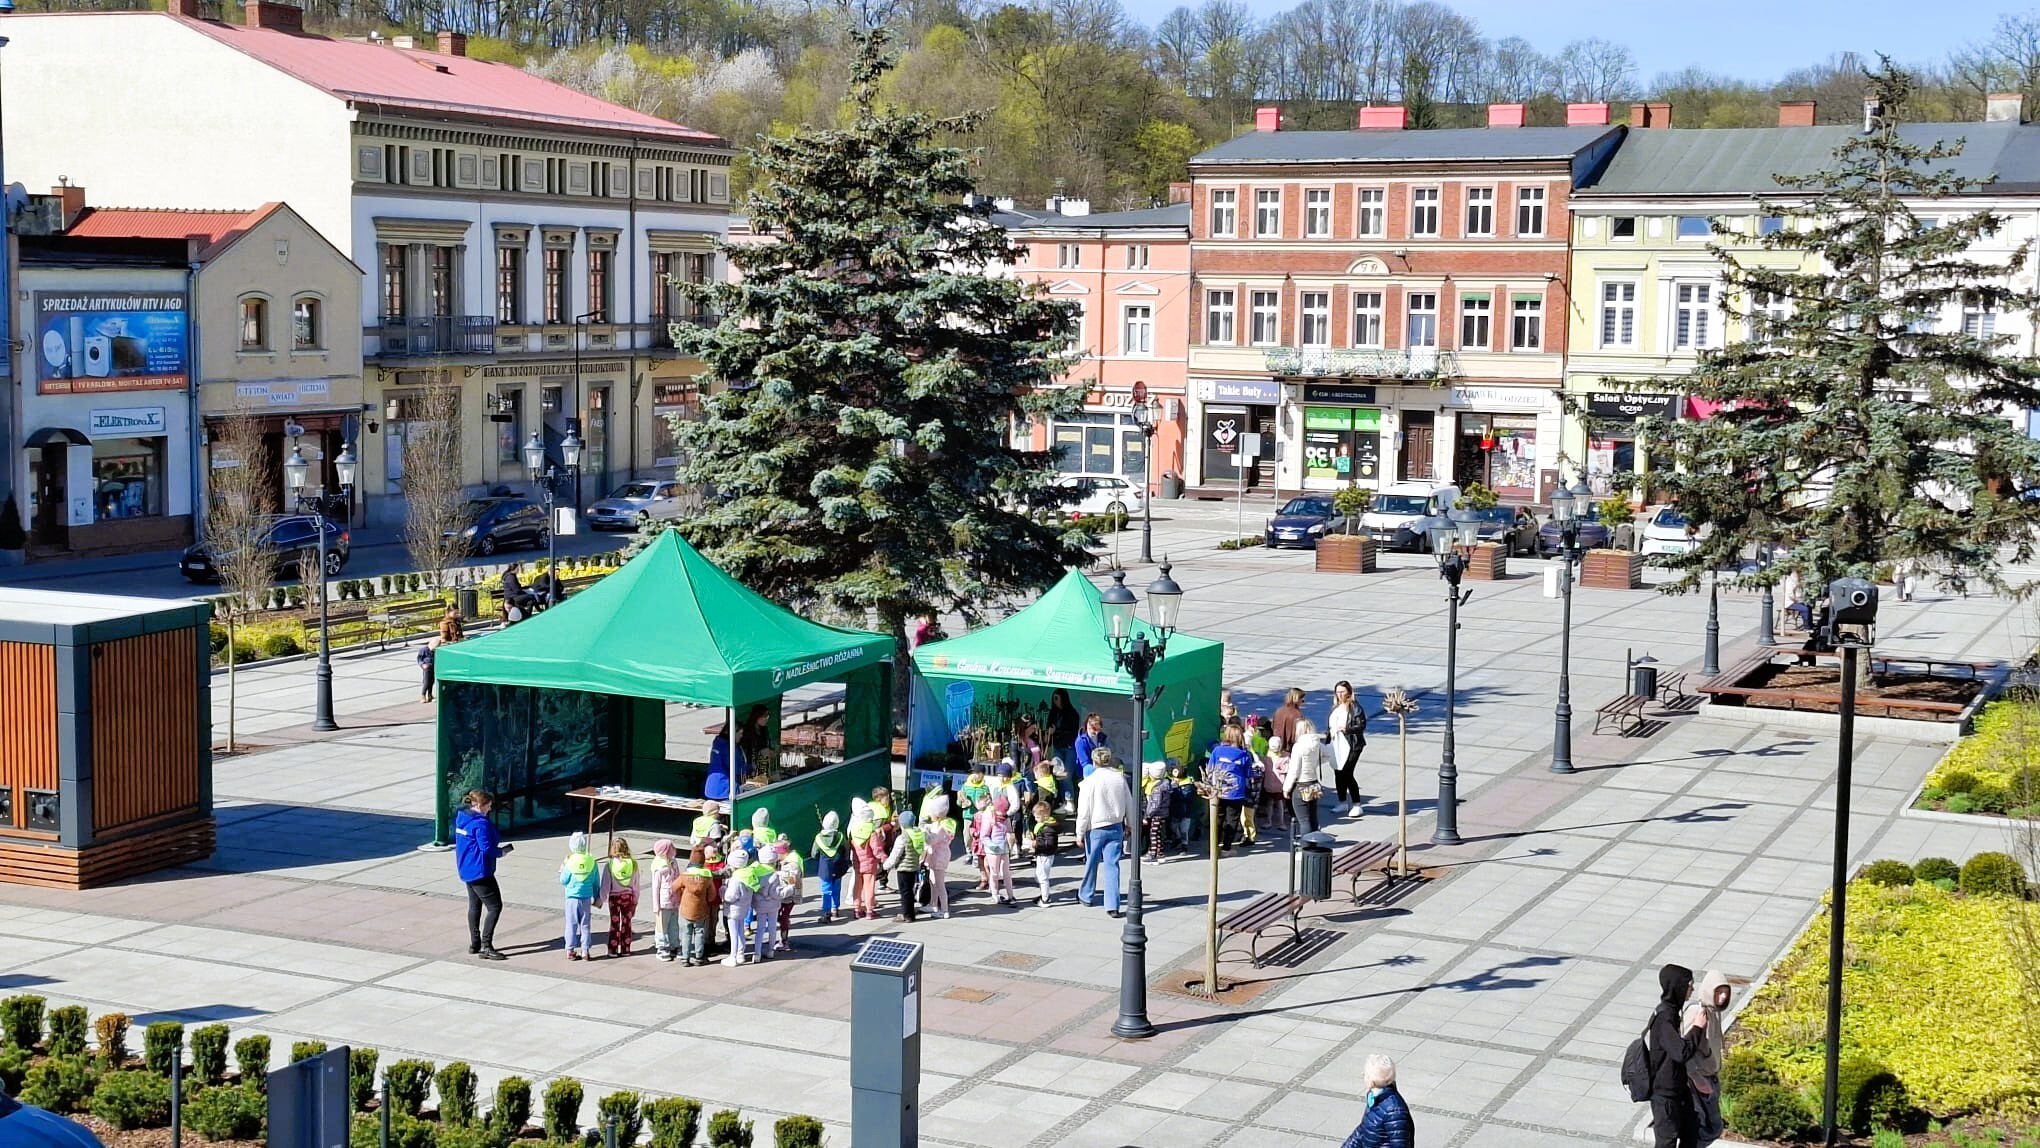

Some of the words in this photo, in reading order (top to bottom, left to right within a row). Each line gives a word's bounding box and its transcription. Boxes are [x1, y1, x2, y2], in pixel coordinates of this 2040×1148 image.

[43, 296, 87, 311] SPRZEDAŻ
[89, 296, 141, 311] ARTYKUŁÓW
[142, 298, 158, 310] RTV
[164, 298, 182, 310] AGD
[1218, 385, 1240, 395] Takie
[1243, 386, 1261, 398] Buty
[1456, 389, 1497, 399] ZABAWKI
[1593, 394, 1620, 402] Salon
[1623, 394, 1669, 405] Optyczny
[786, 657, 833, 680] NADLEŚNICTWO
[835, 647, 864, 664] RÓŻANNA
[907, 974, 915, 994] P
